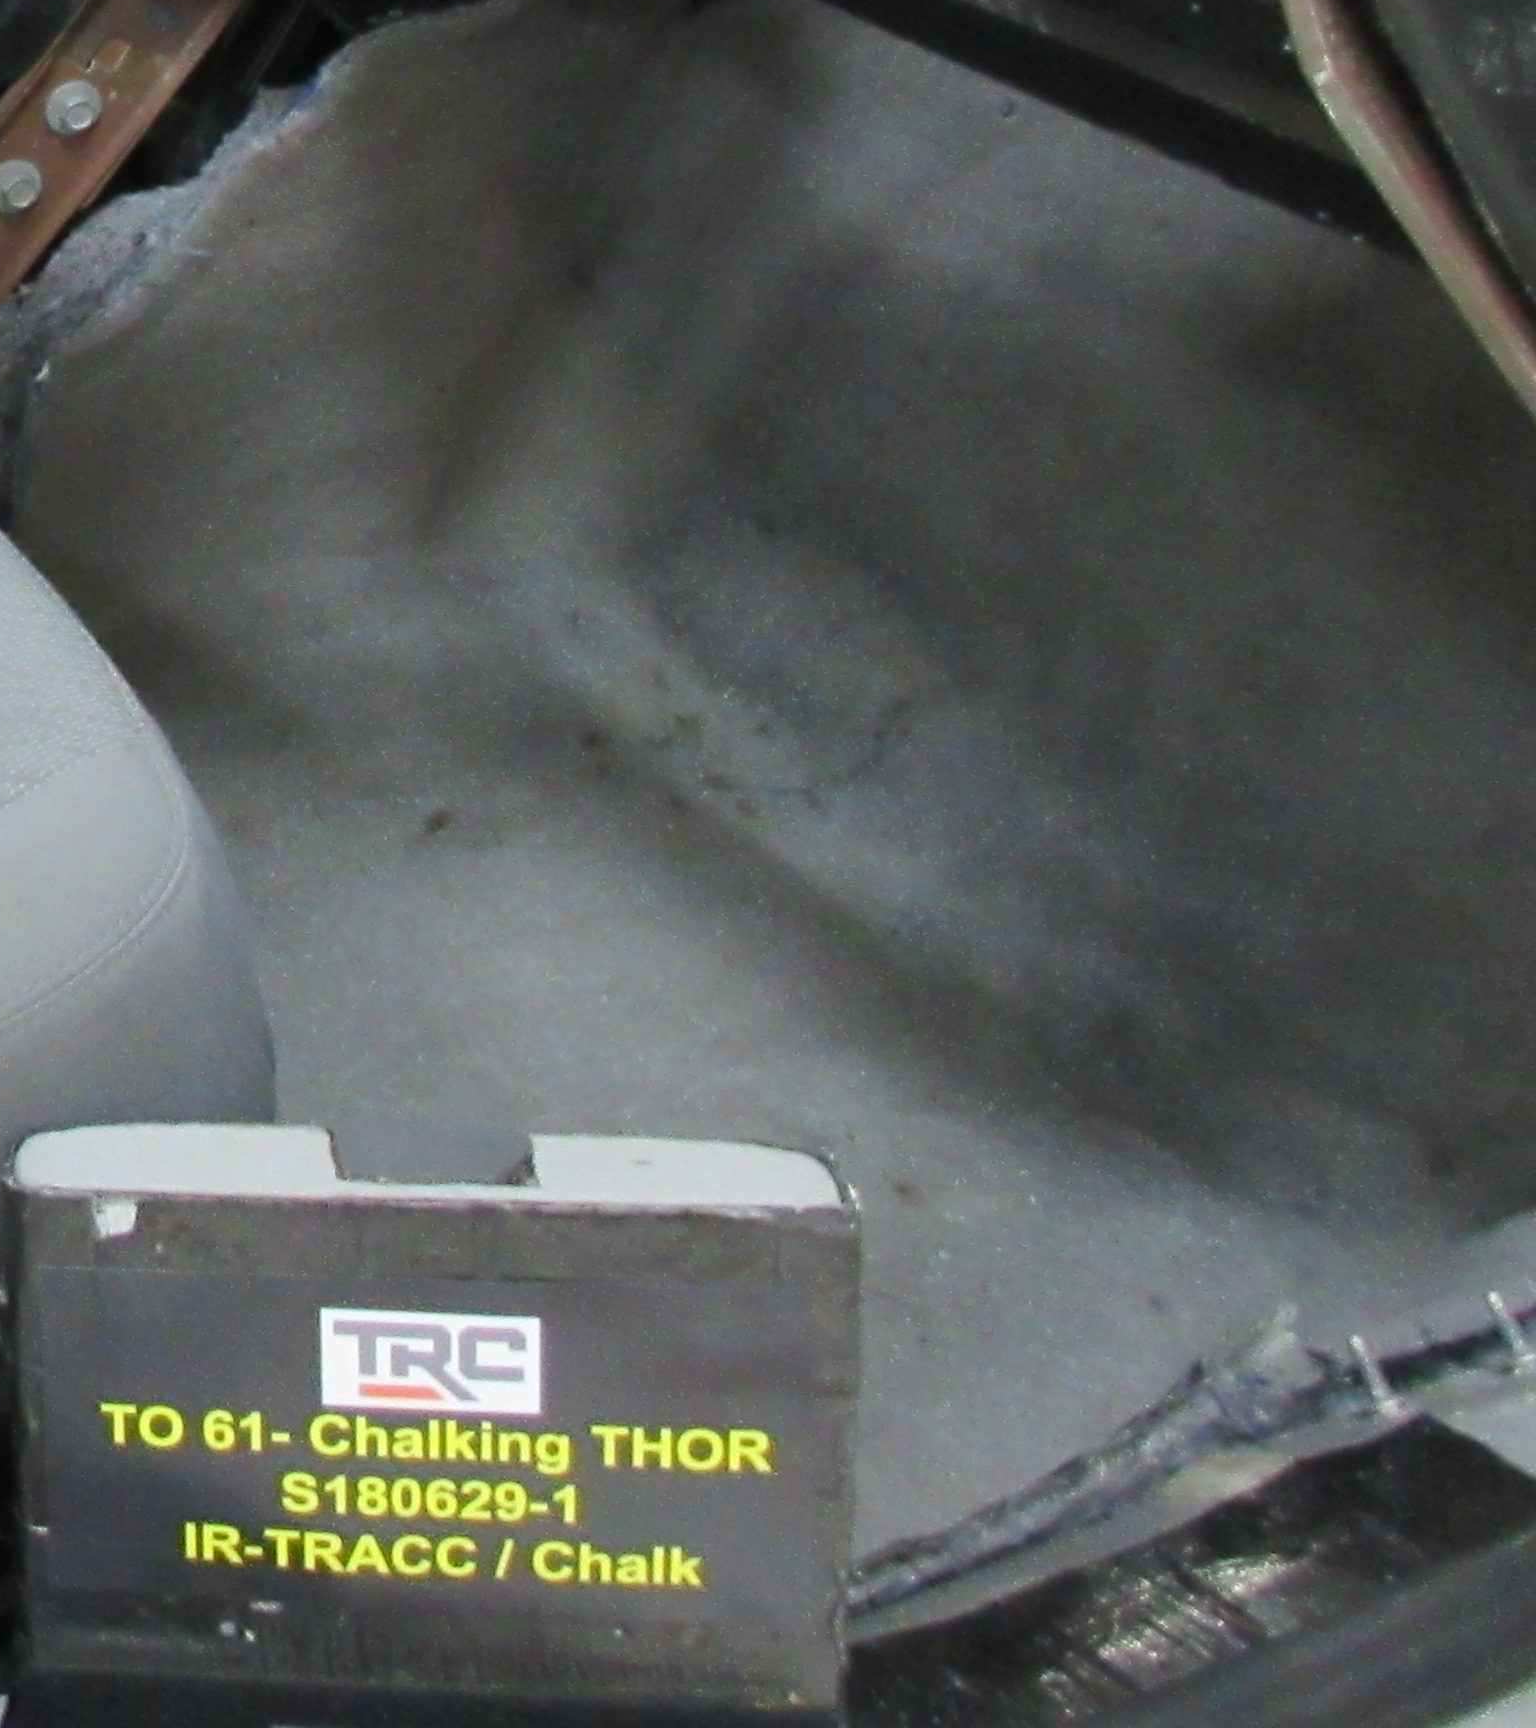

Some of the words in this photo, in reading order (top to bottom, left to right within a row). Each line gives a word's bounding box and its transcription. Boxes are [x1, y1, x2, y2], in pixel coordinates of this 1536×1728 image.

[332, 1320, 527, 1402] TRC
[99, 1401, 184, 1448] TO
[201, 1408, 291, 1452] 61-
[309, 1413, 571, 1475] Chalking
[590, 1424, 773, 1473] THOR
[281, 1471, 578, 1525] S180629-1
[183, 1521, 478, 1577] IR-TRACC
[494, 1538, 515, 1580] /
[531, 1540, 704, 1587] Chalk
